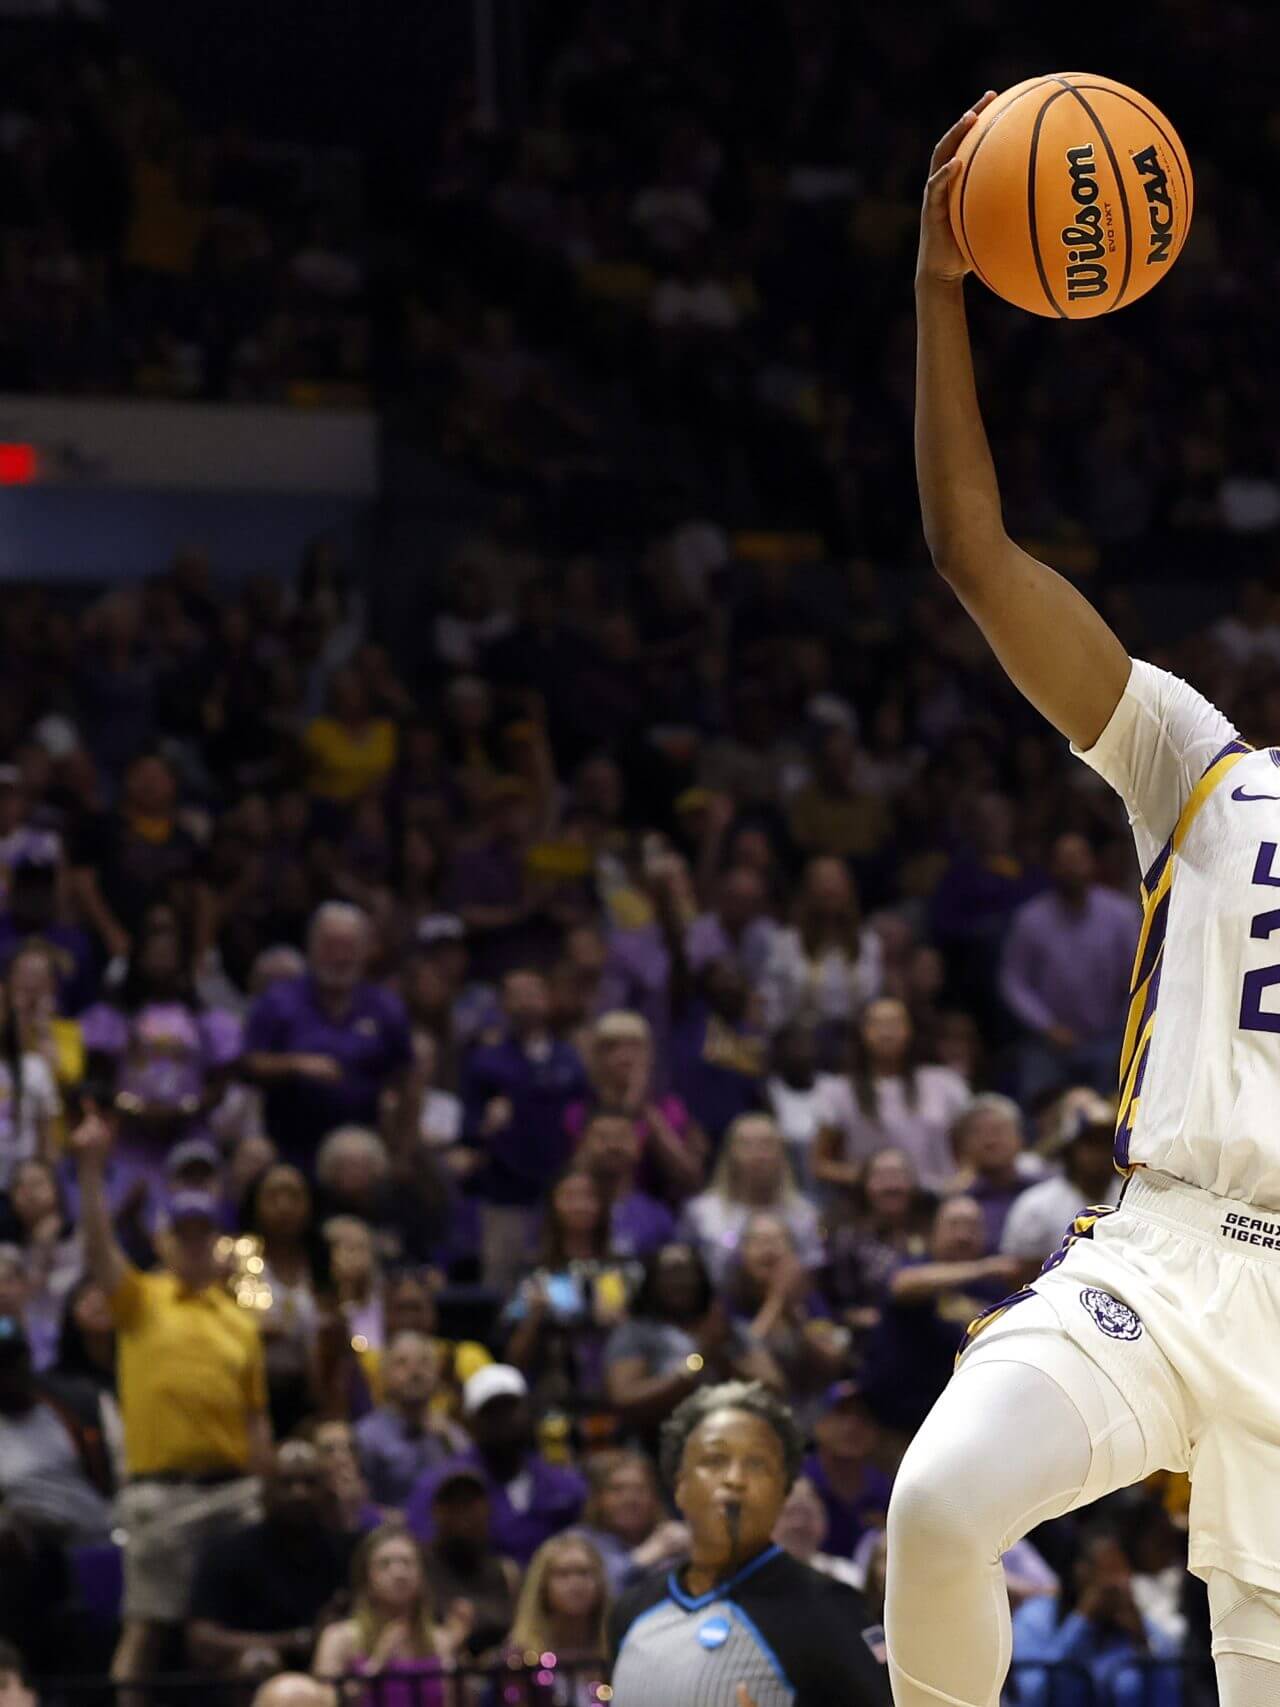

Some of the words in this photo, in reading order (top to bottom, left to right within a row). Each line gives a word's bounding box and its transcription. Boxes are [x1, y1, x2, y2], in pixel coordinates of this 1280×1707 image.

[1061, 143, 1109, 301] Wilson
[1104, 201, 1113, 226] NXT
[1107, 229, 1116, 253] EVO
[1132, 145, 1174, 265] NCAA
